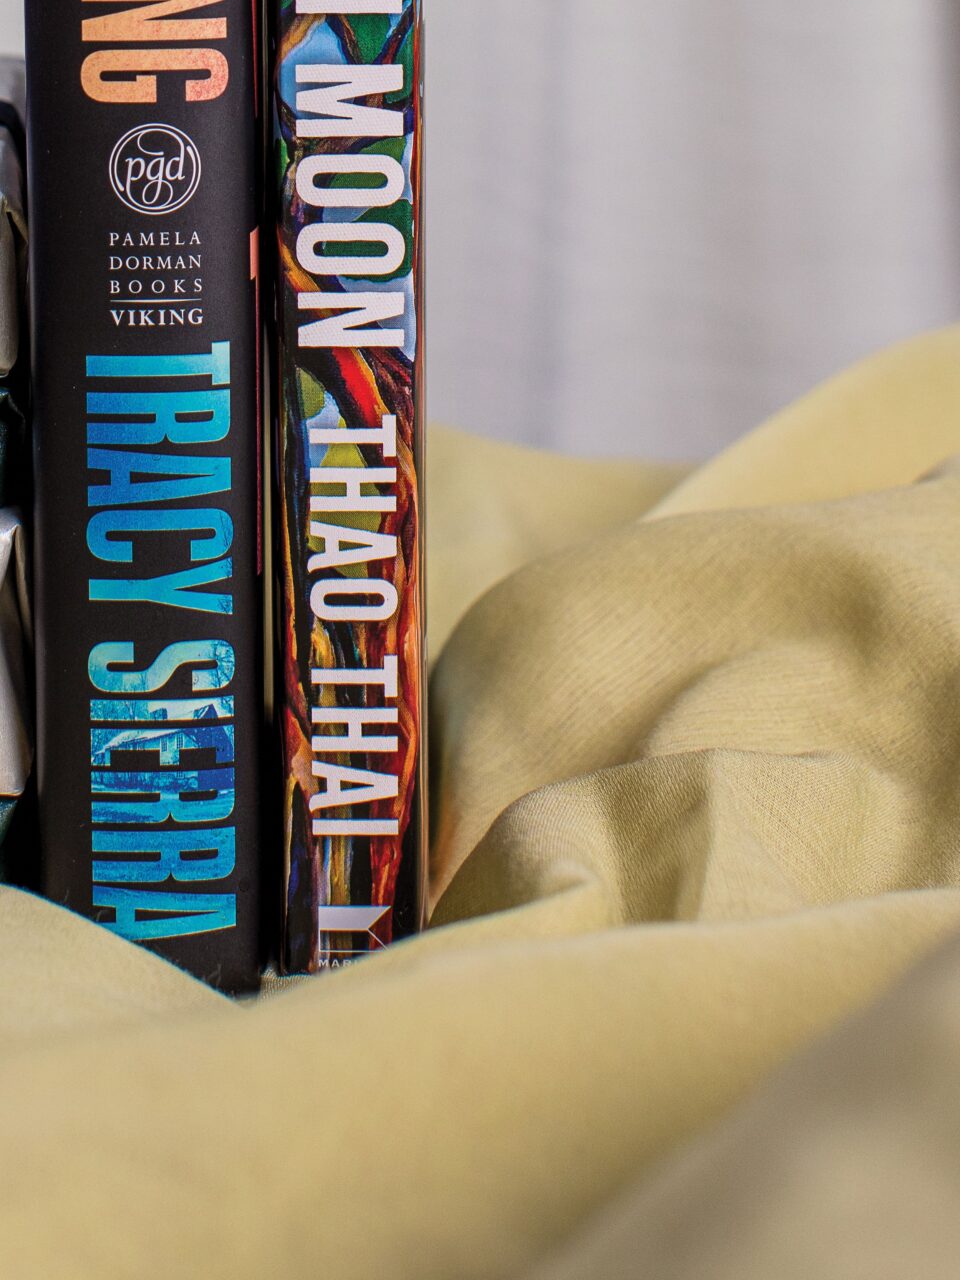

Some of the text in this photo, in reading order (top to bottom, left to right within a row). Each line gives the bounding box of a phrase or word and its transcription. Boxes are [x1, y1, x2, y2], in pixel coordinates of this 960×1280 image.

[296, 63, 407, 350] MOON
[109, 231, 201, 246] PAMELA
[109, 254, 201, 270] DORMAN
[110, 278, 203, 294] BOOKS
[110, 308, 204, 326] VIKING
[307, 414, 399, 836] THAO THAI
[85, 341, 237, 942] TRACY SIERRA
